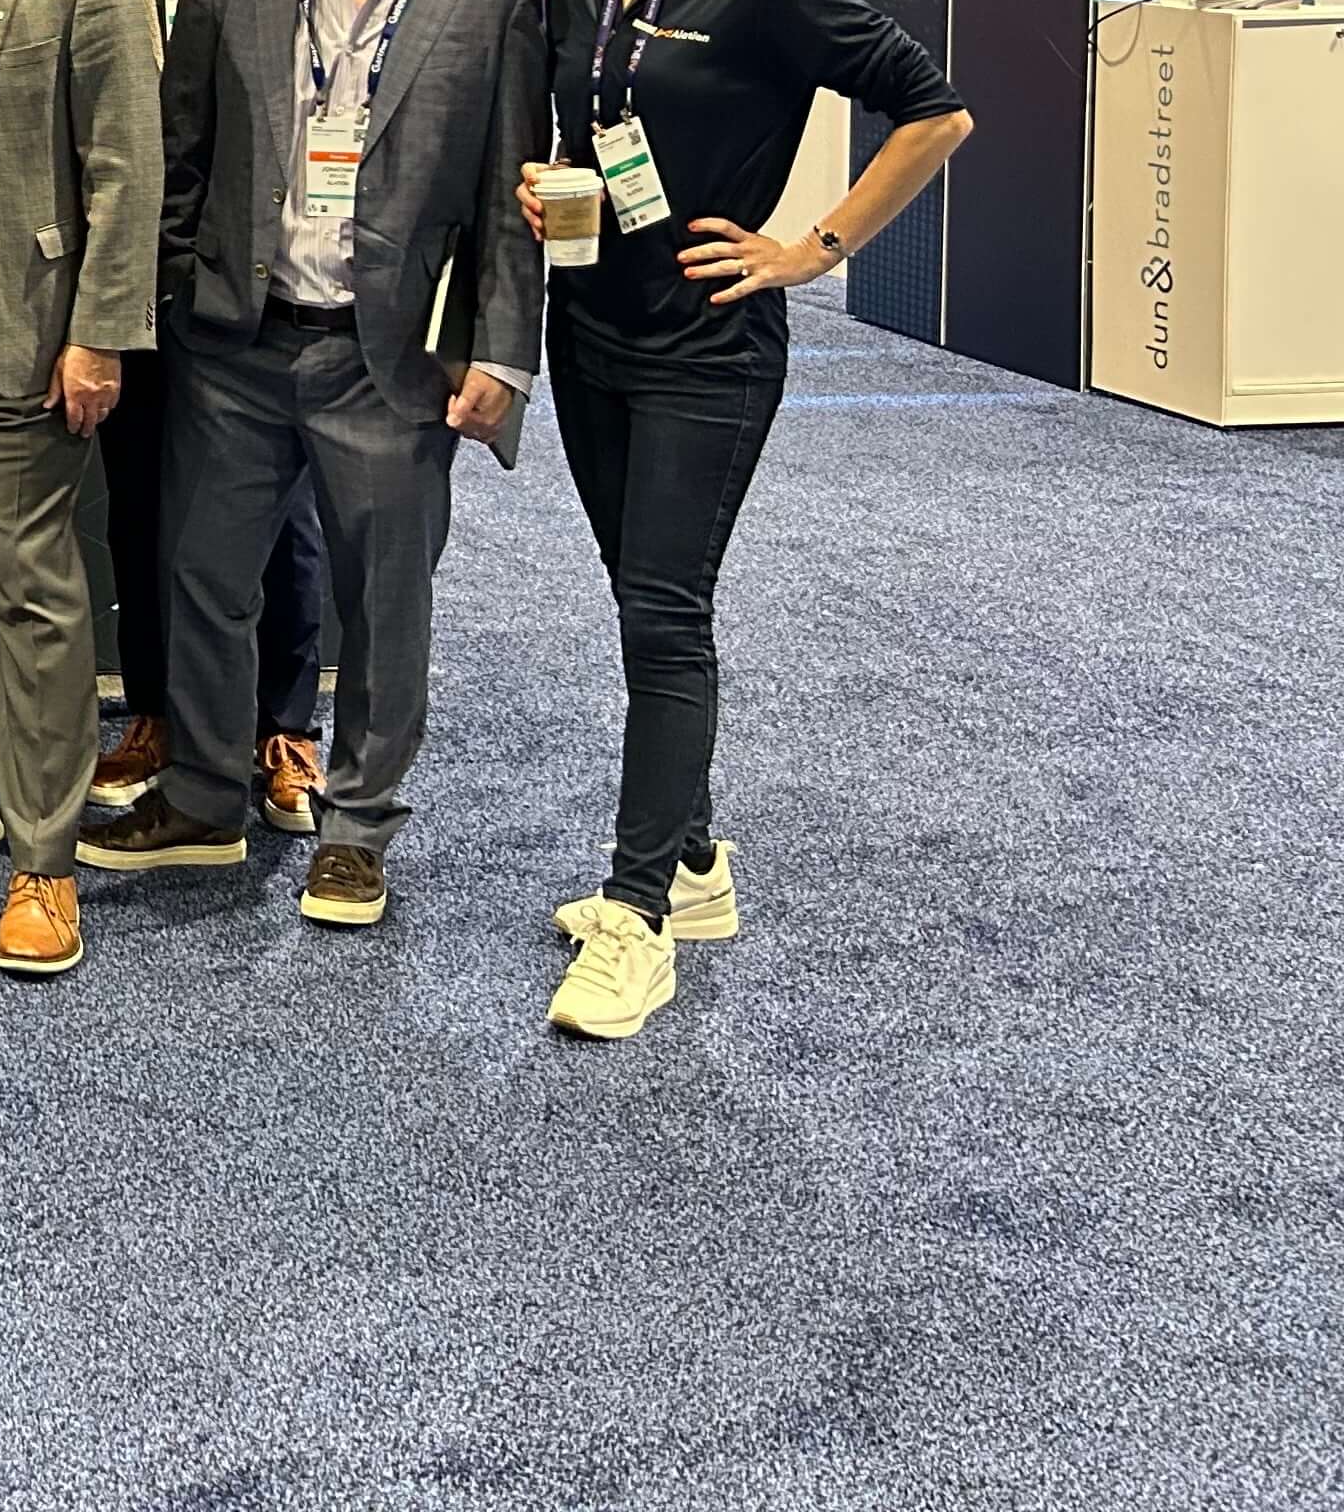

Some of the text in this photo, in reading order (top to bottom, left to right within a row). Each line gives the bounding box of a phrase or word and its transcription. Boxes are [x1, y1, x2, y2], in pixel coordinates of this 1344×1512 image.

[372, 39, 388, 74] Gartner
[671, 28, 710, 43] Alation
[1147, 44, 1175, 249] bradstreet
[1145, 300, 1169, 370] dun
